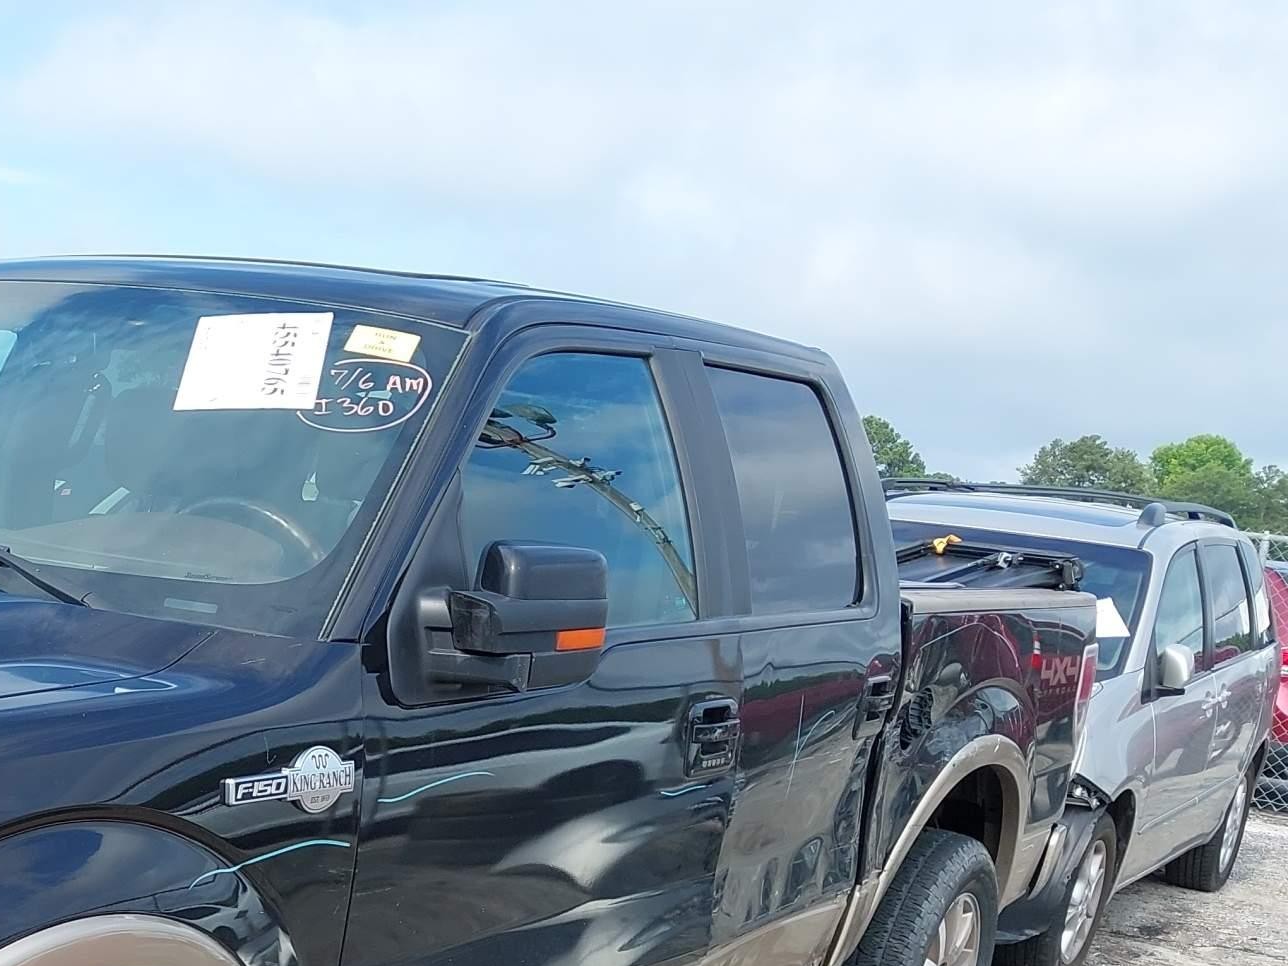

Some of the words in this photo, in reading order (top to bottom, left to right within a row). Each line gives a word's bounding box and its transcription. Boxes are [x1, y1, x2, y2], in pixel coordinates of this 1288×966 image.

[260, 323, 300, 396] 45540765
[330, 367, 375, 391] 7/6
[236, 777, 287, 800] F-150
[292, 773, 317, 793] KING
[318, 766, 351, 789] RANCH
